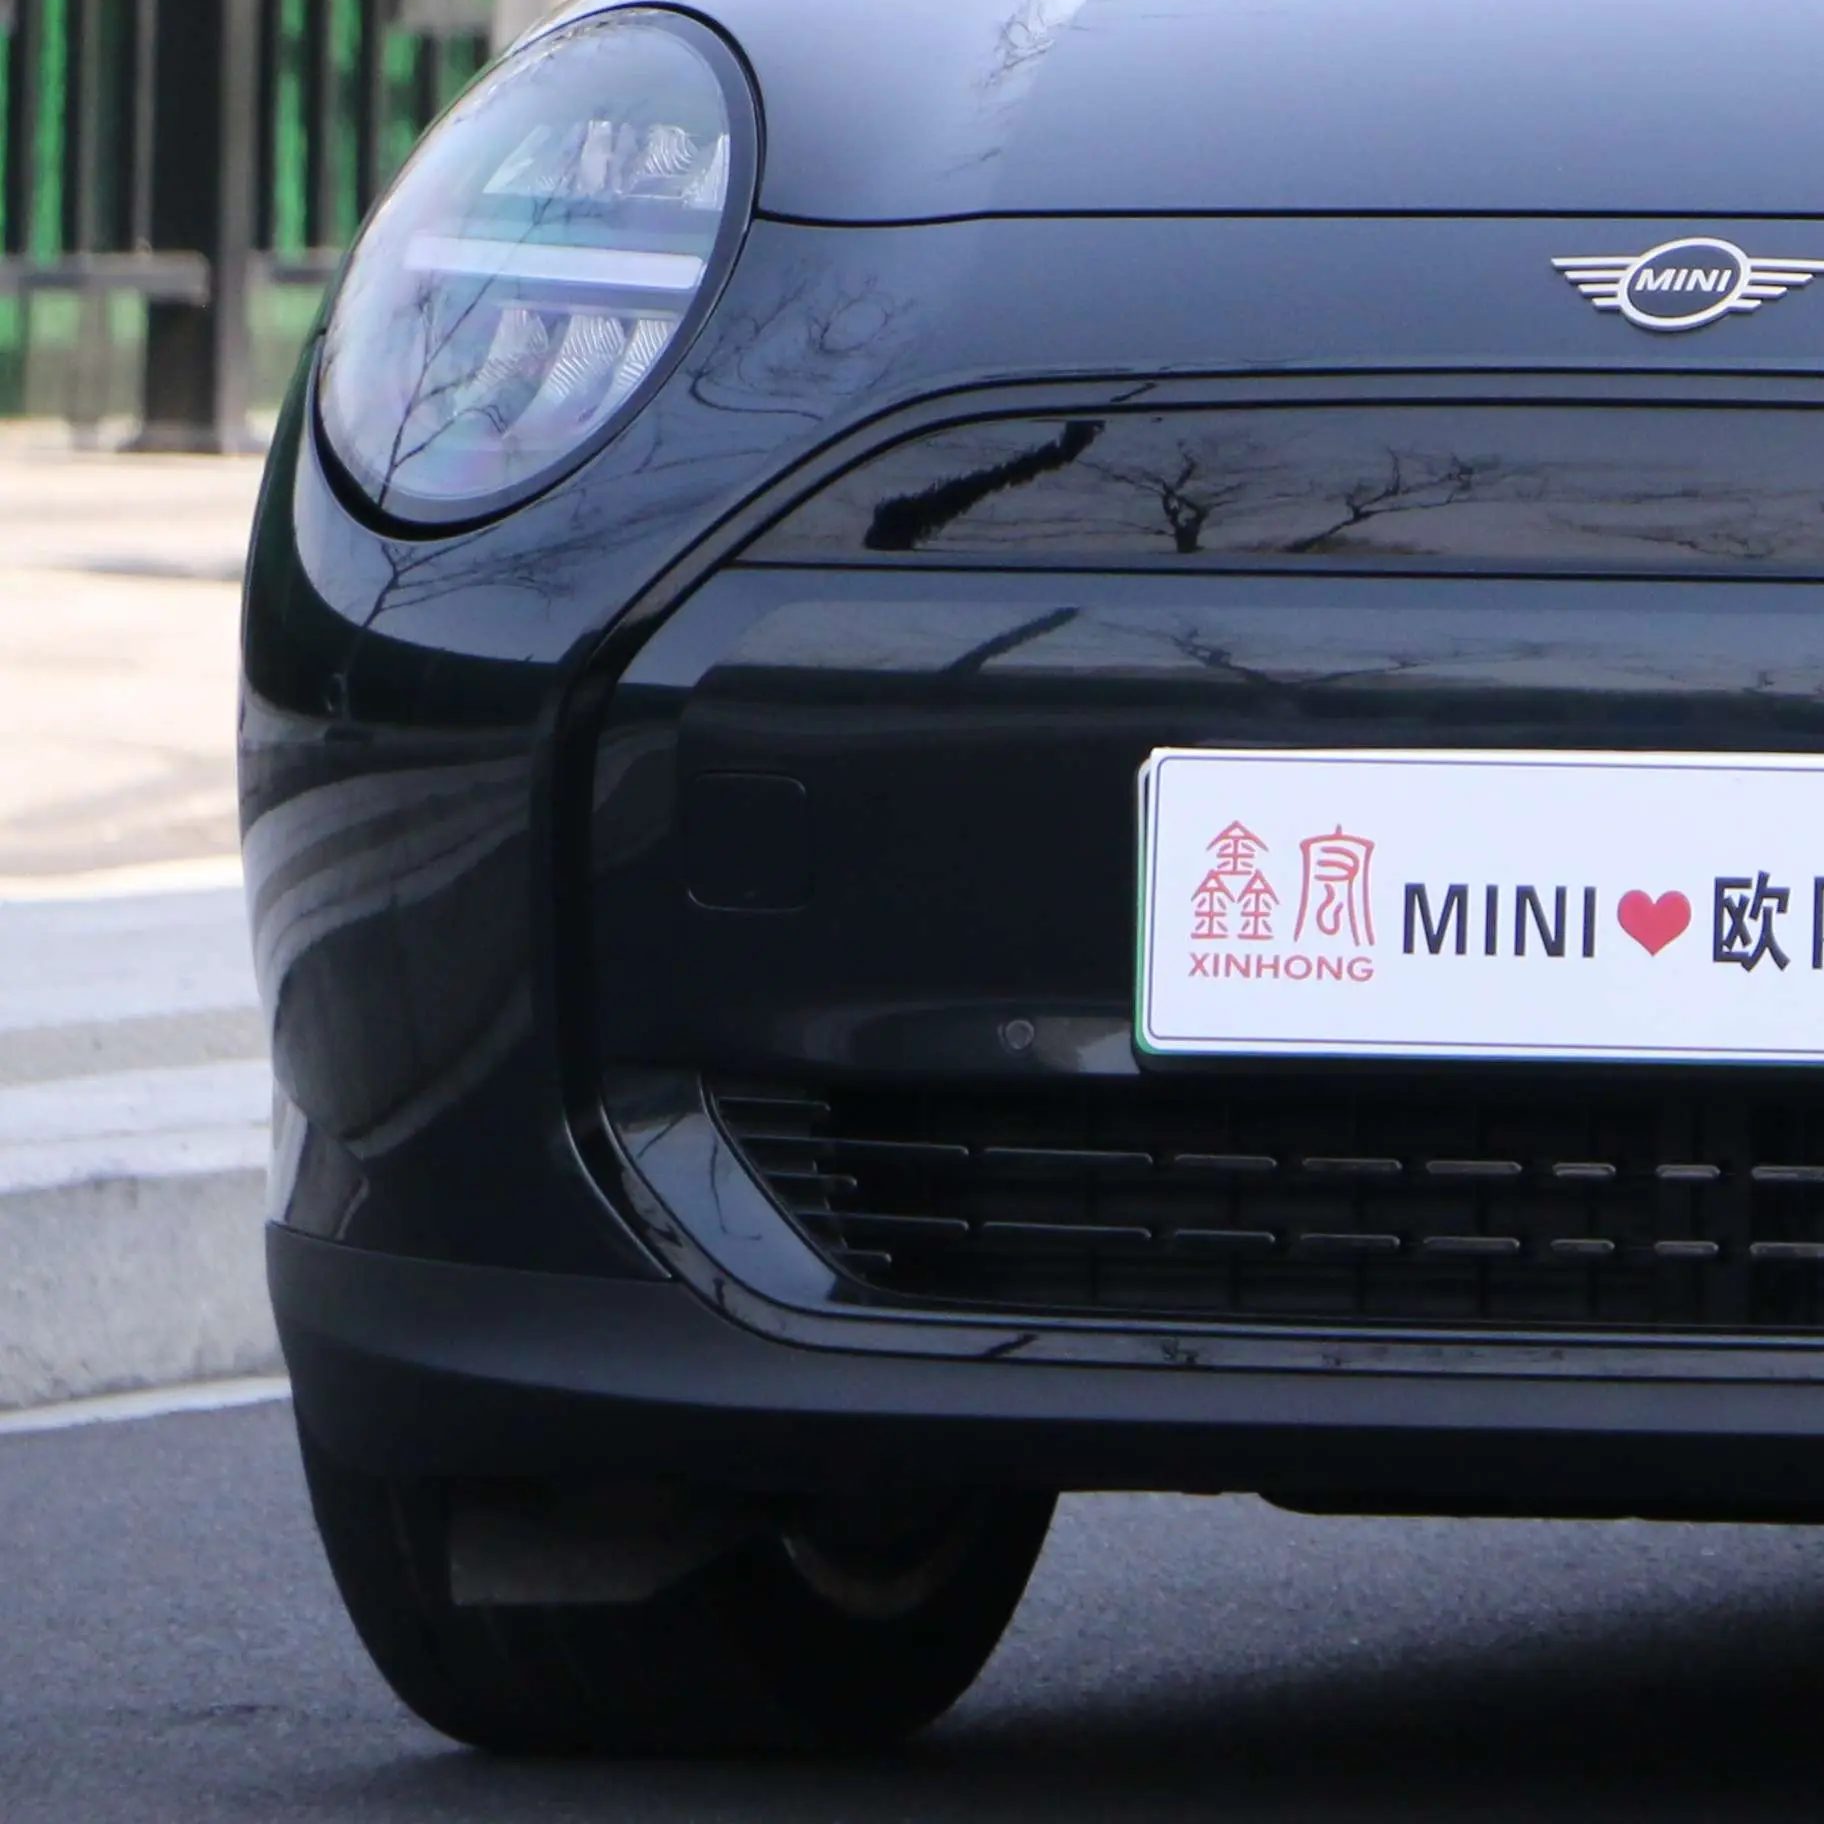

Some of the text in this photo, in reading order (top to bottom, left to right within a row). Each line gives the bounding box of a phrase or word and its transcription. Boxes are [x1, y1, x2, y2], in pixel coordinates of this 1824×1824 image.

[1634, 268, 1733, 294] MINI
[1402, 882, 1597, 958] MINI
[1188, 951, 1375, 982] XINHONG
